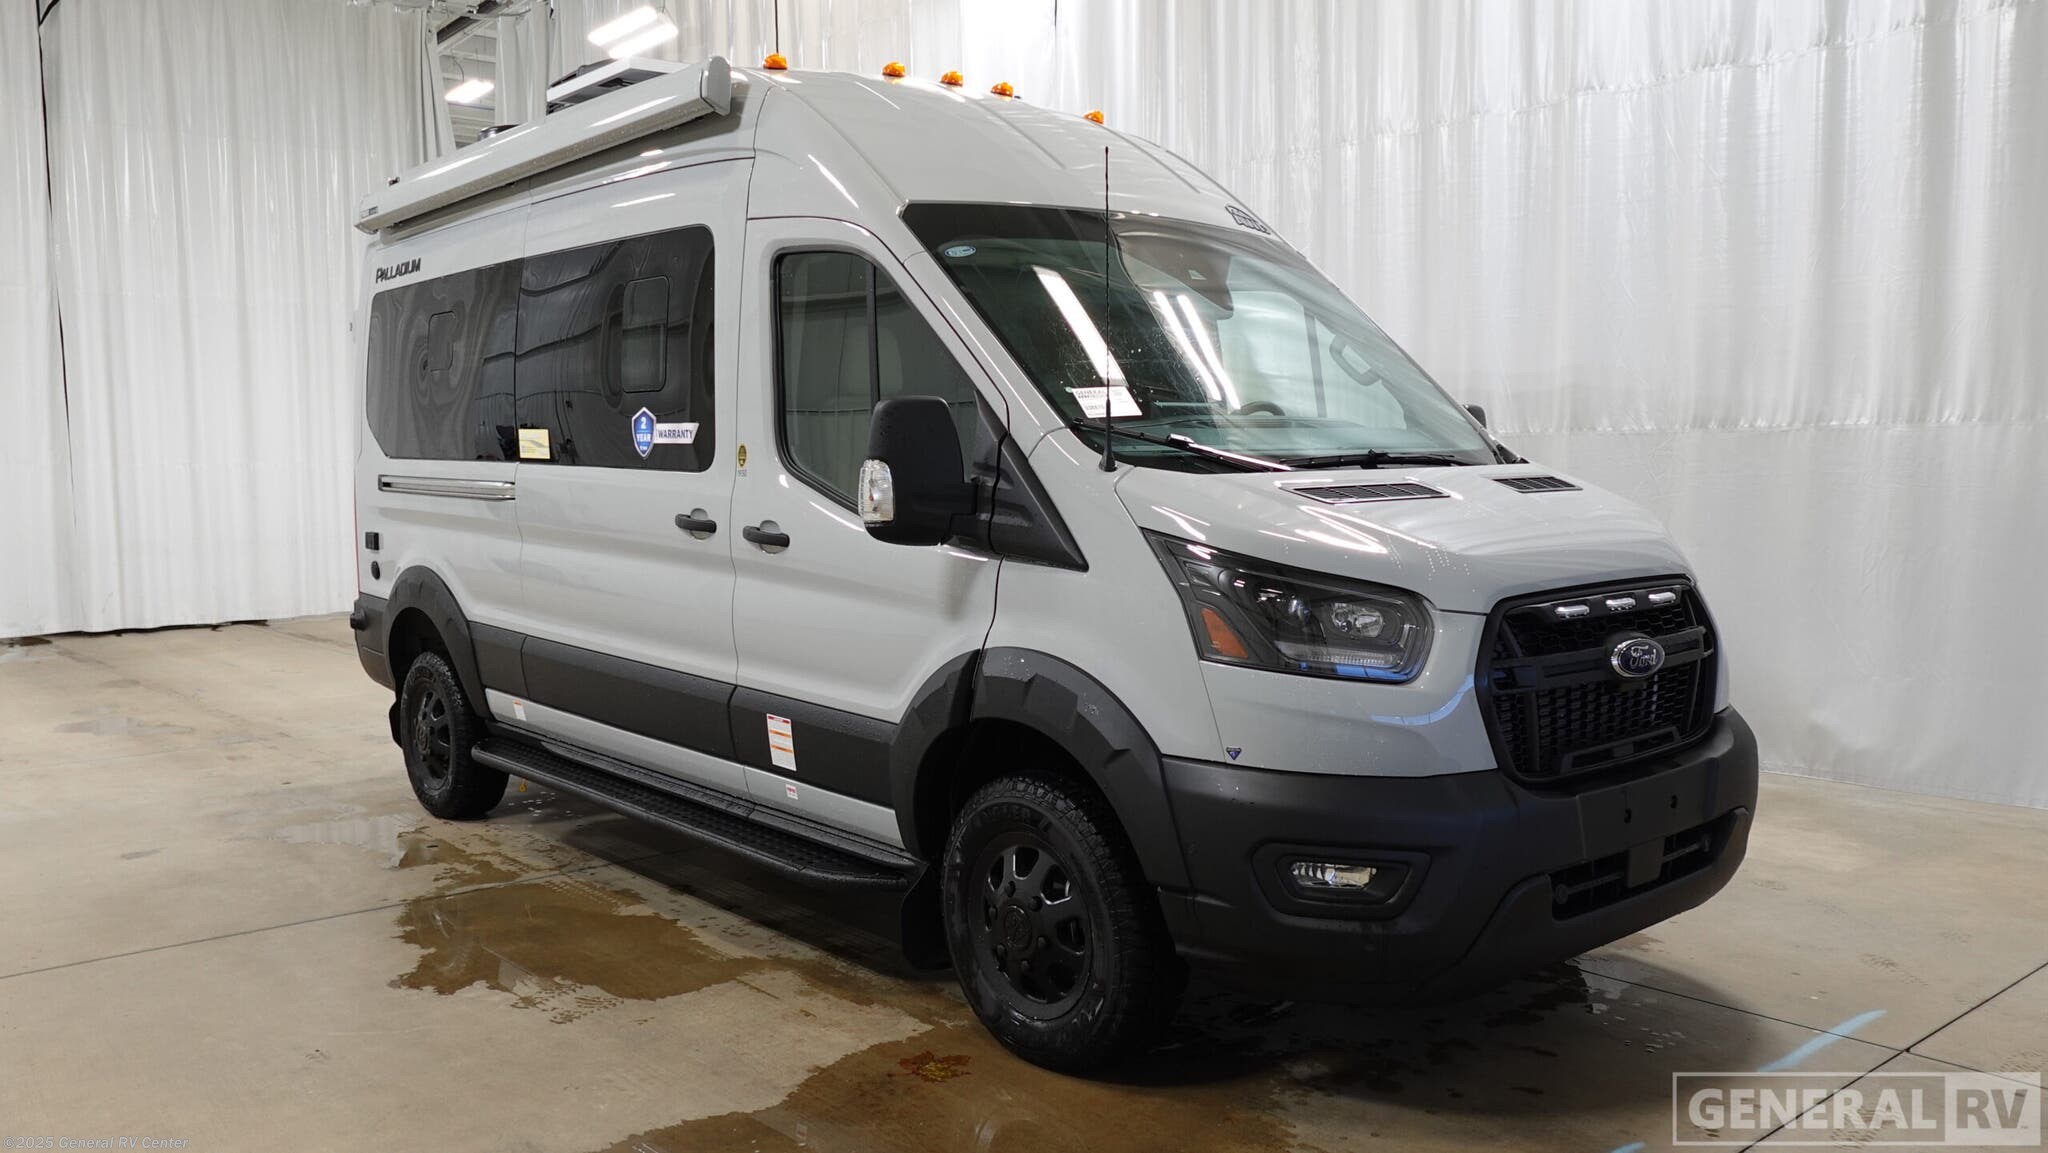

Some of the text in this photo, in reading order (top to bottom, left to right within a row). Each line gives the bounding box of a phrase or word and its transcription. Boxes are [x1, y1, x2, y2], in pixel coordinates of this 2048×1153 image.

[375, 257, 421, 284] PALLADIUM
[640, 416, 647, 429] 2
[635, 433, 651, 443] YEAR
[657, 429, 693, 439] WARRANTY
[1630, 645, 1656, 668] Ford
